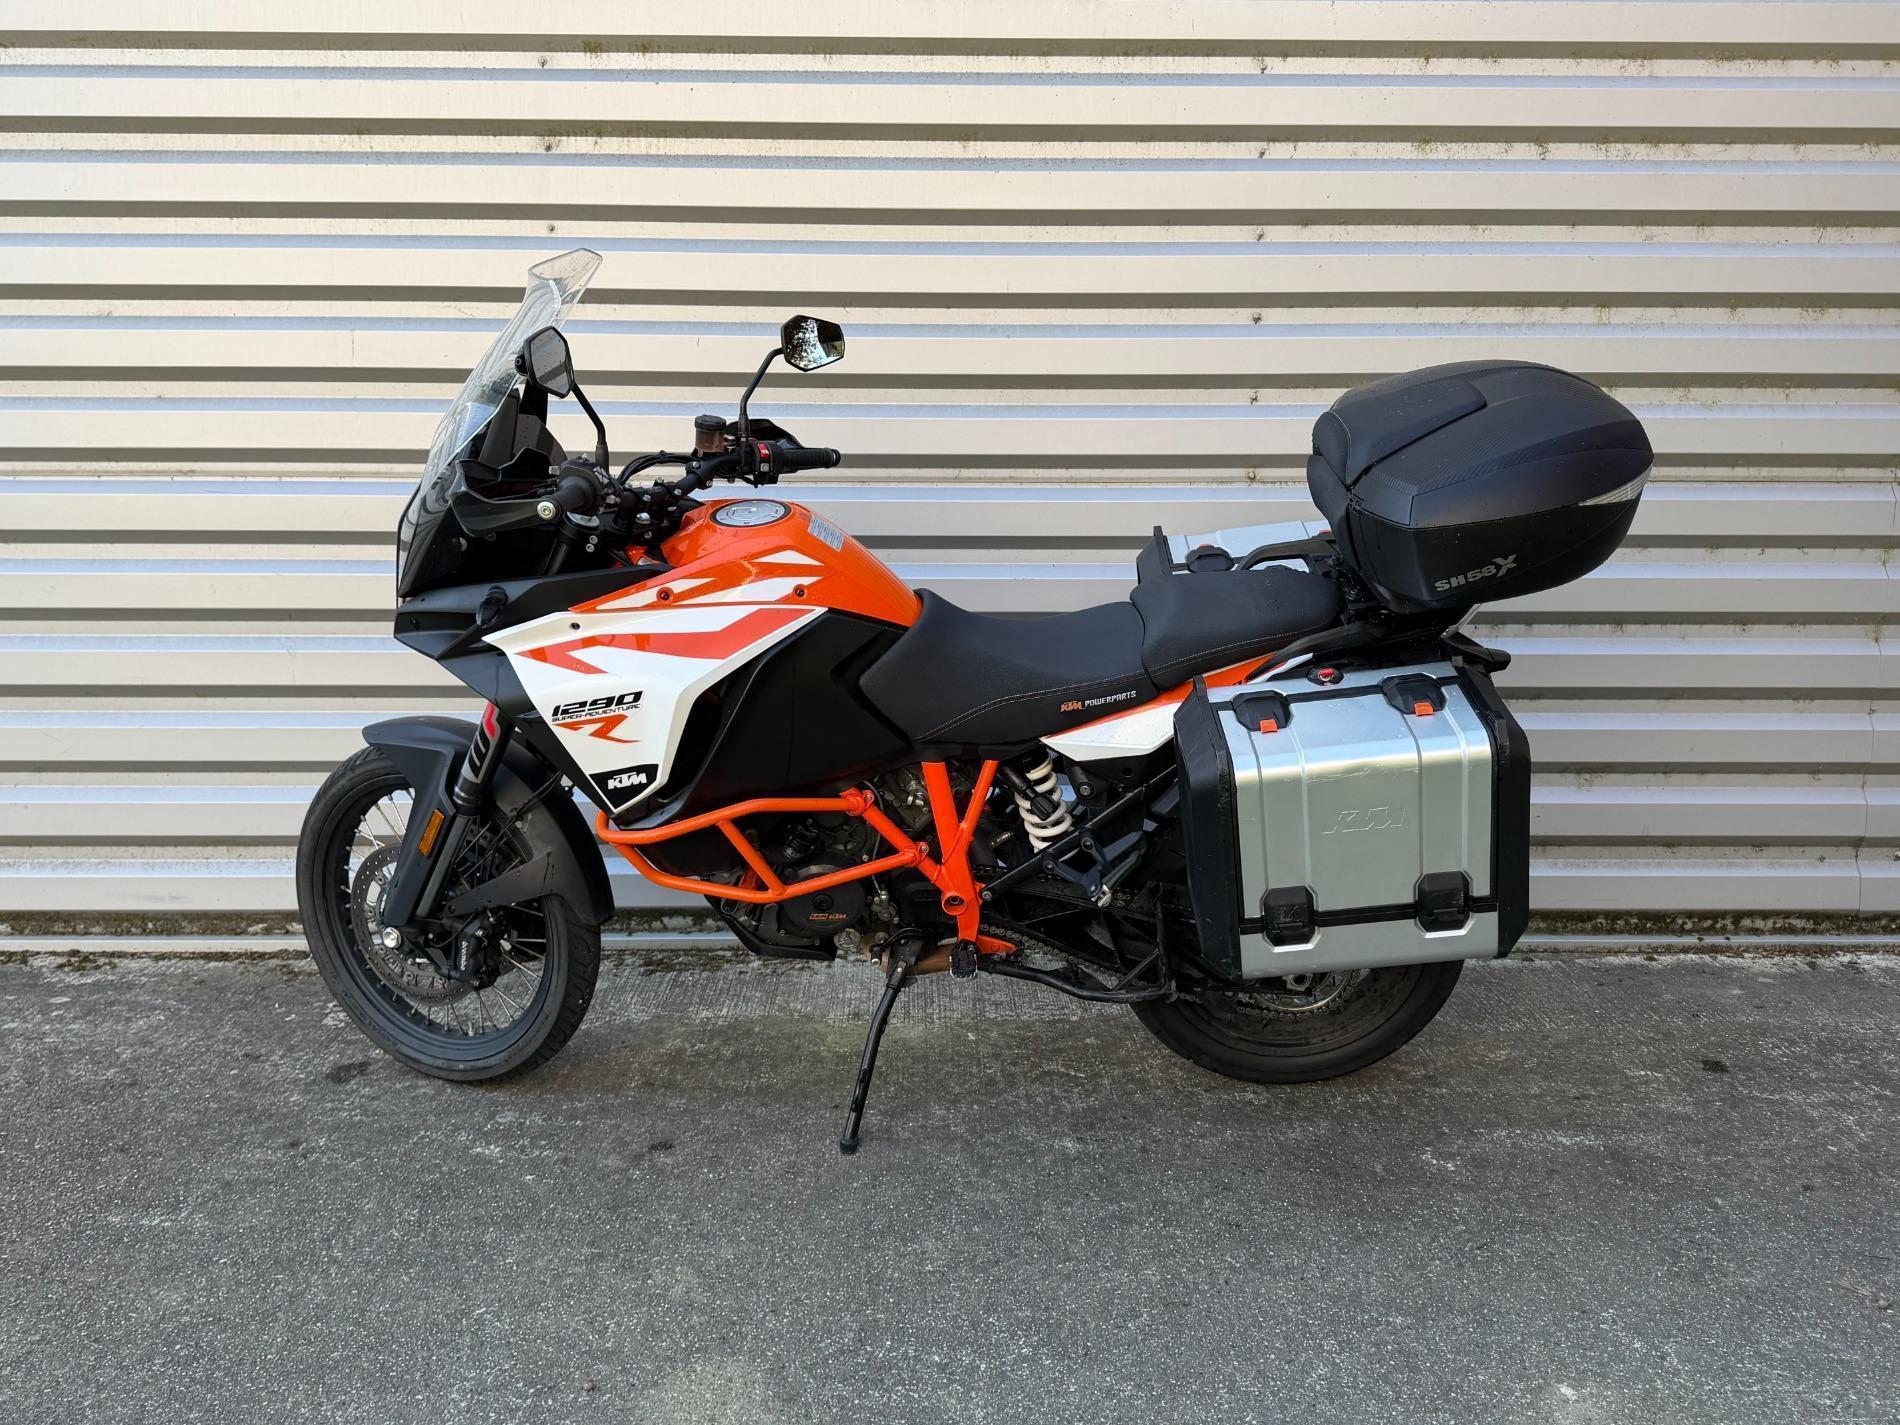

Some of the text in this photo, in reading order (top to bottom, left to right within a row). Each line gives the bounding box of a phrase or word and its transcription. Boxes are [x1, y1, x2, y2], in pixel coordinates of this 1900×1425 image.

[1434, 553, 1517, 592] SH58X
[551, 690, 644, 717] 1290
[1084, 690, 1137, 708] POWERPARTS
[551, 703, 641, 723] SUPER-ADVENTURE
[607, 771, 648, 790] KTM
